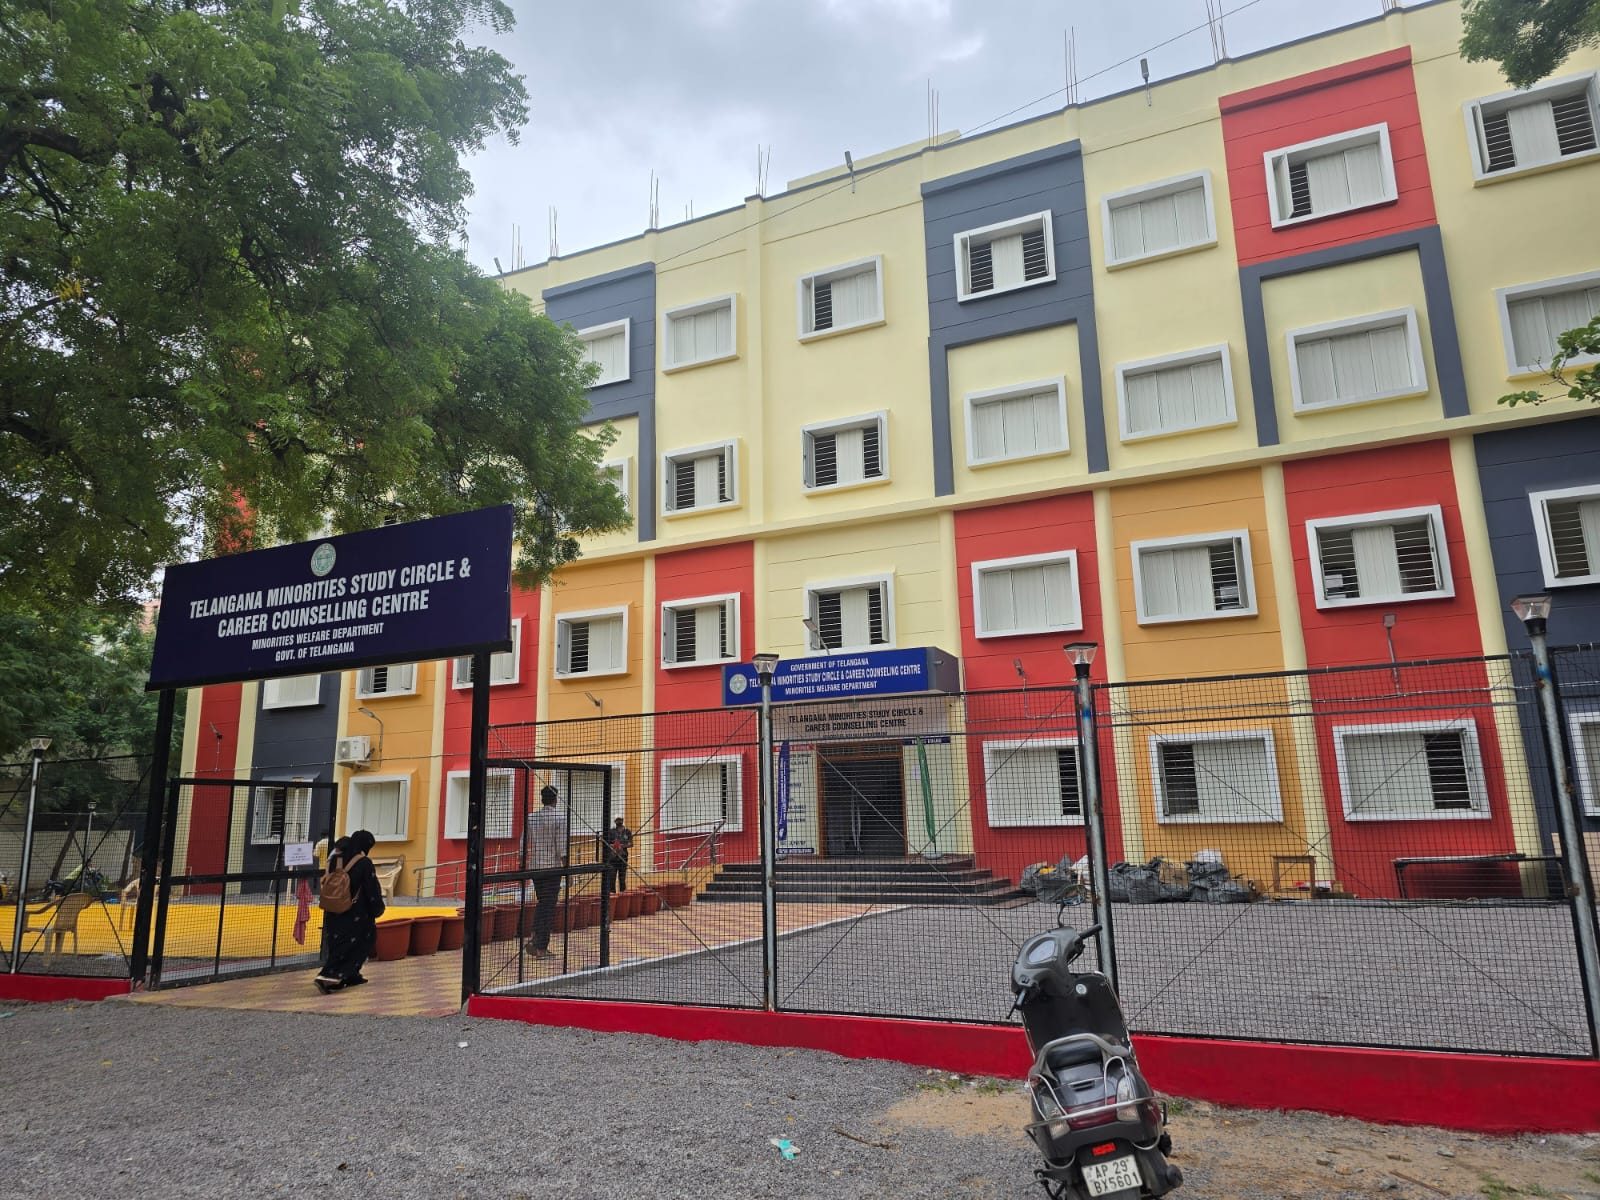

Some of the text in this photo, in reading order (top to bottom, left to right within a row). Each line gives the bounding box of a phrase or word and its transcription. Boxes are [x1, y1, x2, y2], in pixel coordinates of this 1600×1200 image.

[189, 557, 472, 619] TELANGANA MINORITIES STUDY CIRCLE &
[217, 589, 430, 638] CAREER COUNSELLING CENTRE
[251, 622, 385, 650] MINORITIES WELFARE DEPARTMENT
[275, 641, 355, 662] GOVT. OF TELANGANA
[777, 671, 804, 686] MINORITIES
[805, 669, 821, 683] STUDY
[821, 668, 840, 681] CIRCLE
[841, 668, 845, 680] &
[846, 667, 866, 680] CAREER
[866, 664, 900, 679] COUNSELING
[900, 663, 921, 676] CENTRE
[790, 657, 869, 672] GOVERNMENT OF TELANGANA
[785, 680, 878, 695] MINORITIES WELFARE DEPARTMENT
[788, 713, 827, 723] TELANGANA
[828, 711, 867, 721] MINORITIES
[868, 709, 890, 719] STUDY
[891, 707, 917, 717] CIRCLE
[805, 718, 907, 732] CAREER COUNSELLING CENTRE
[1095, 1164, 1108, 1179] AP
[1112, 1160, 1128, 1175] 29
